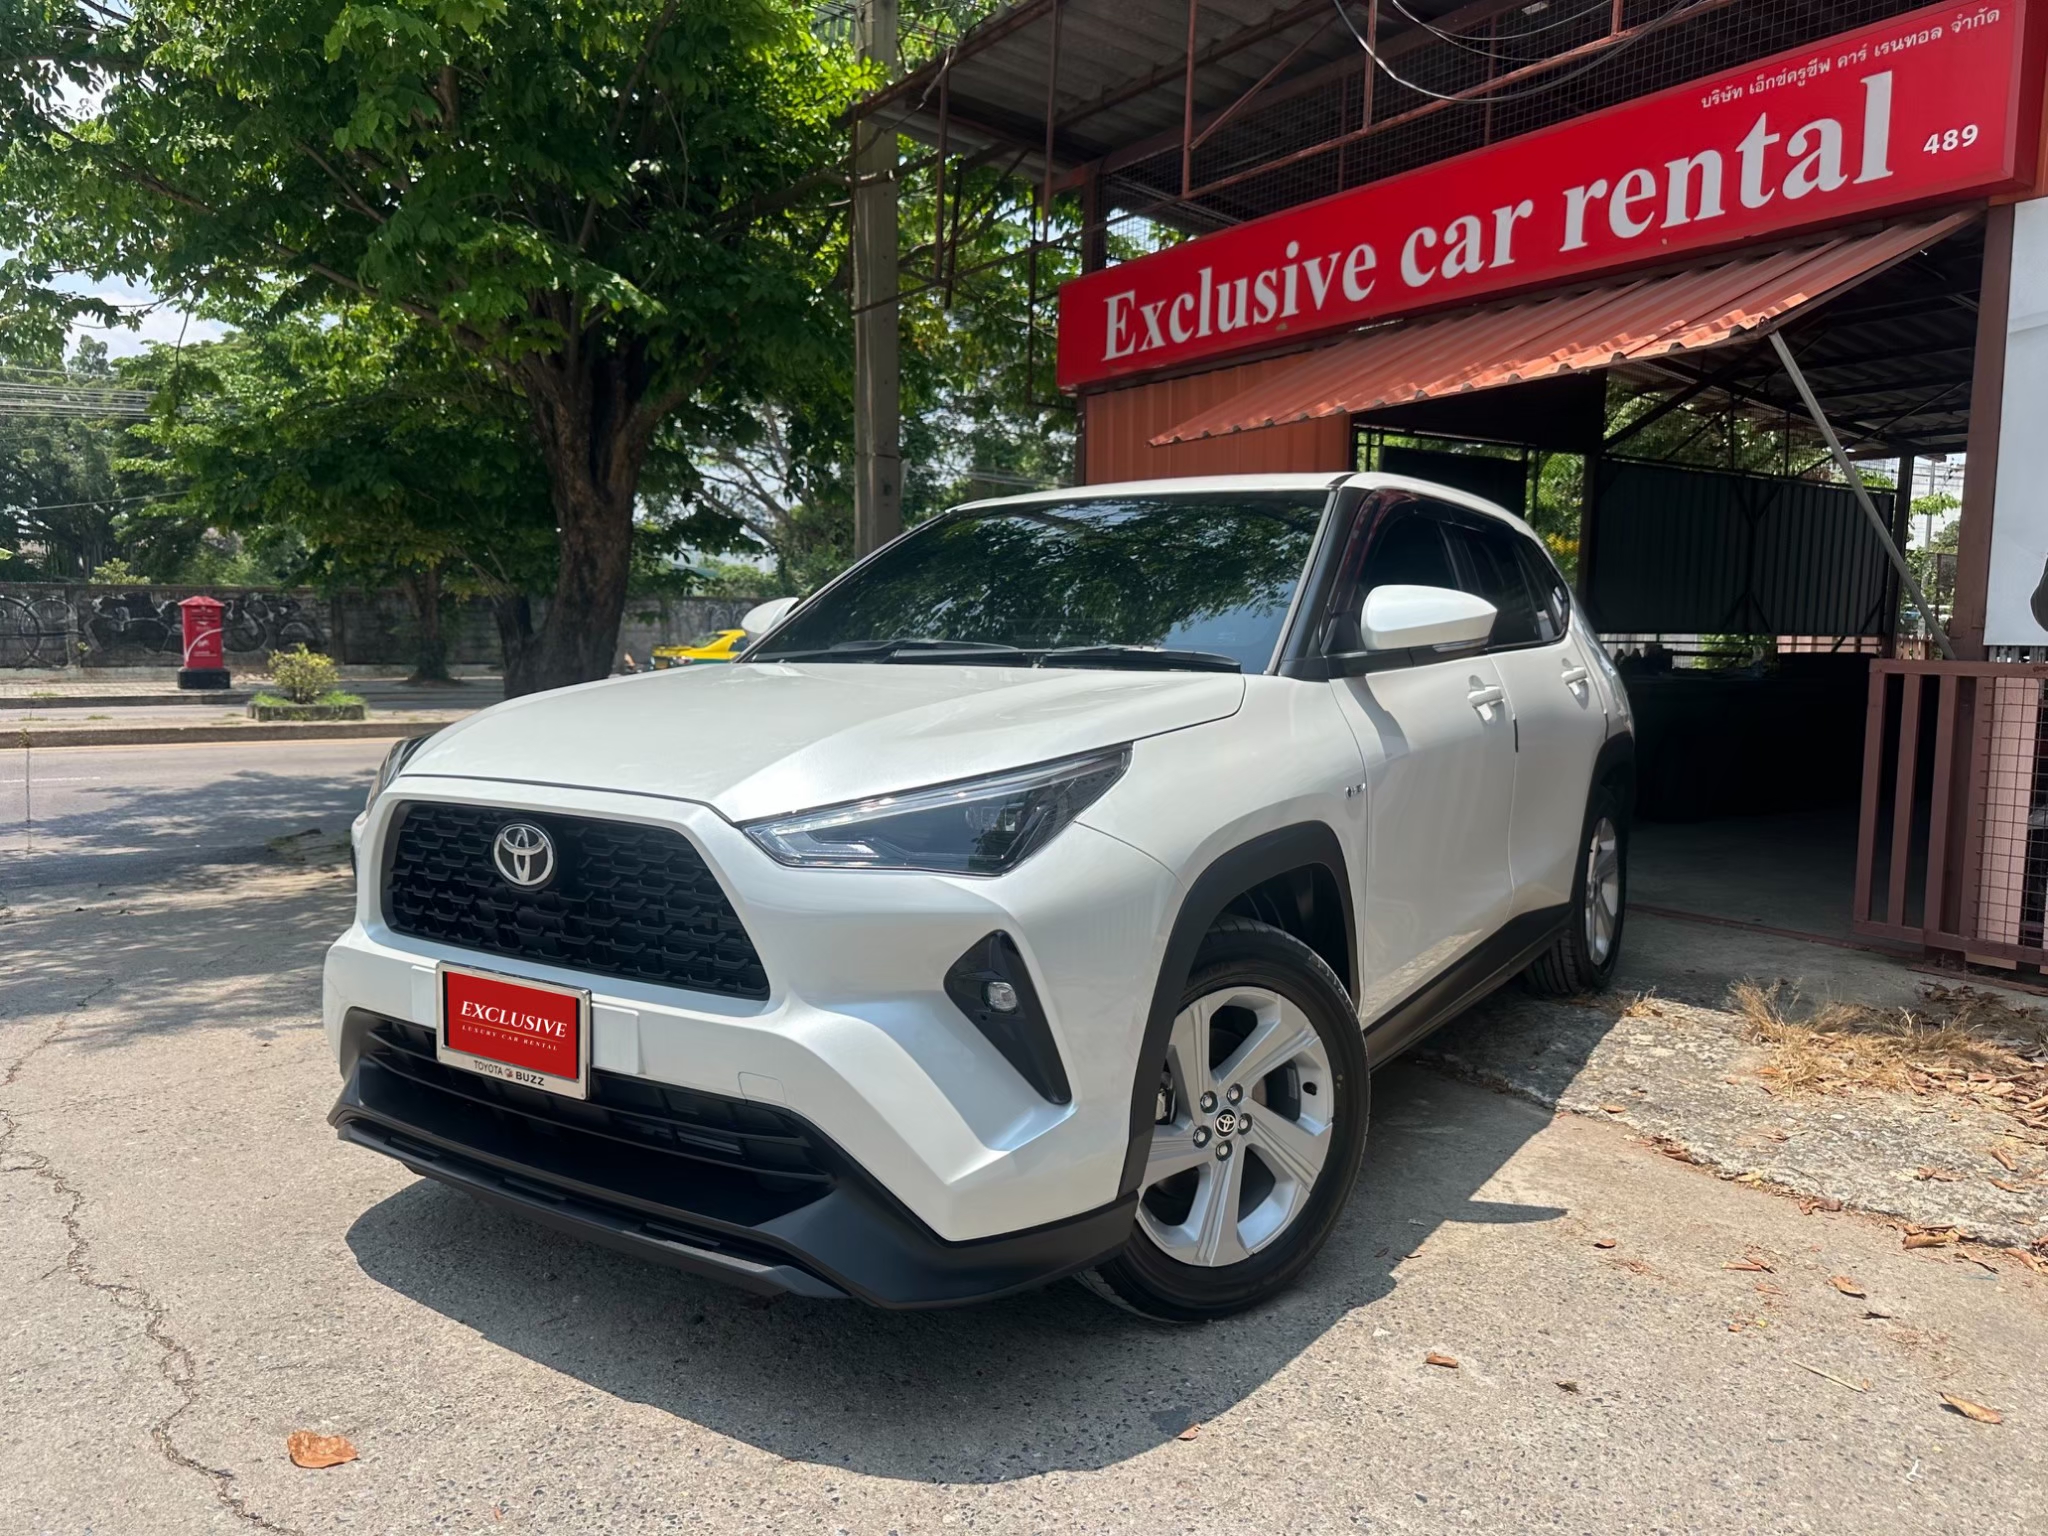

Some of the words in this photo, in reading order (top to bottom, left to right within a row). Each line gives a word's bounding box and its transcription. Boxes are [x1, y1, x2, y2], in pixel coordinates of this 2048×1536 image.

[1701, 85, 1743, 109] บริษัท
[1837, 43, 1868, 68] คาร์
[1874, 25, 1943, 57] เรนทอล
[1951, 7, 2000, 33] จำกัด
[1922, 124, 1979, 155] 489
[1103, 242, 1378, 361] Exclusive
[1400, 199, 1534, 288] car
[1559, 70, 1894, 252] rental
[460, 1000, 568, 1038] EXCLUSIVE
[462, 1025, 497, 1037] LUXURY
[501, 1034, 519, 1042] CAR
[523, 1038, 558, 1051] RENTAL
[473, 1060, 503, 1075] TOYOTA
[515, 1071, 545, 1086] BUZZ
